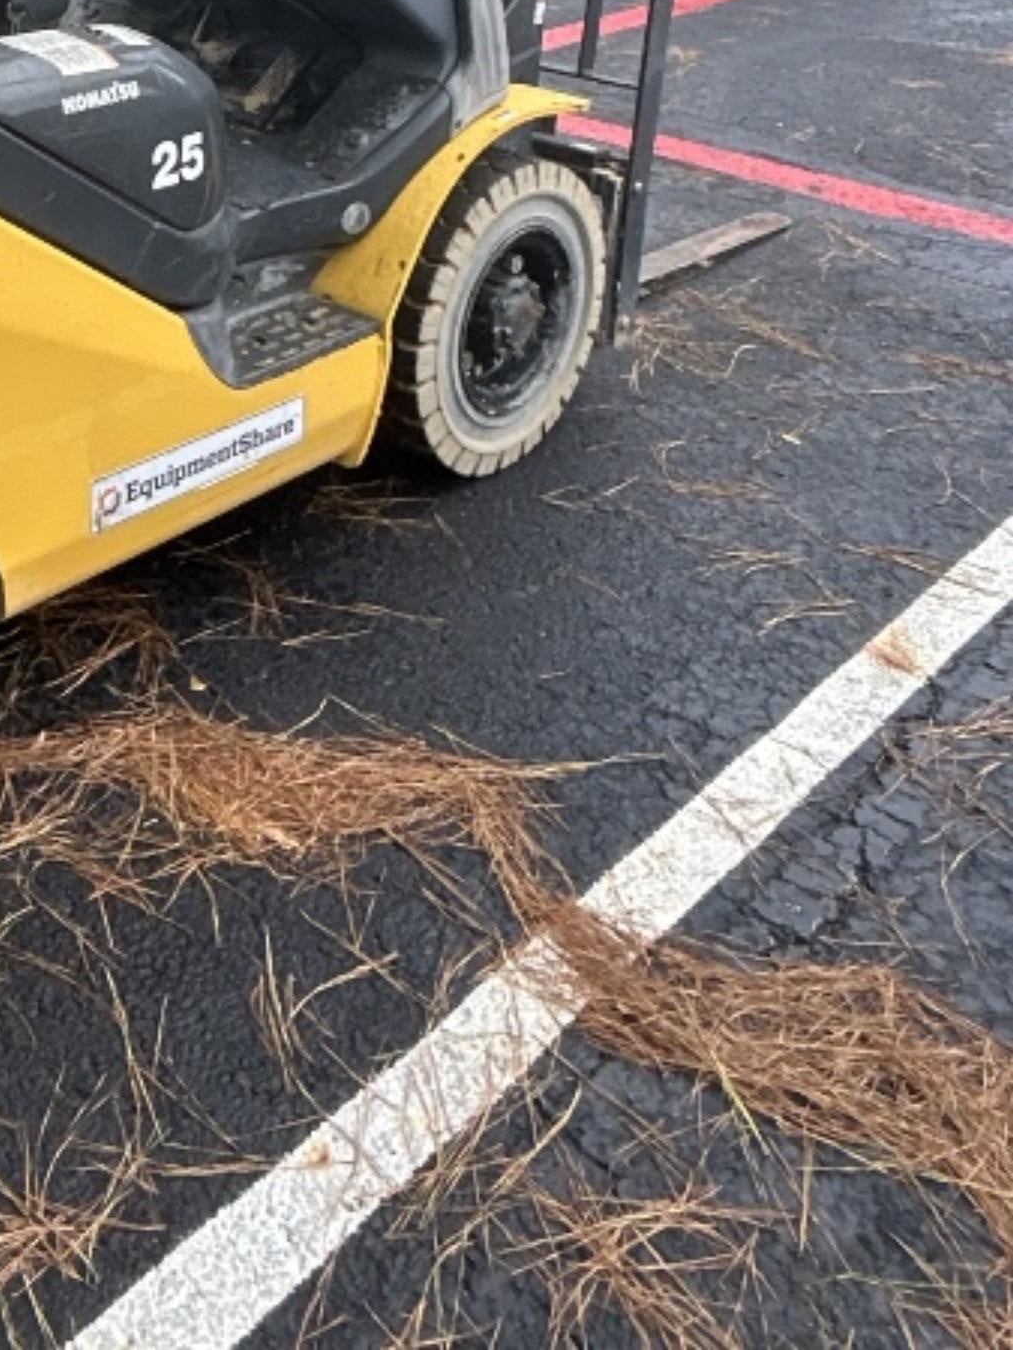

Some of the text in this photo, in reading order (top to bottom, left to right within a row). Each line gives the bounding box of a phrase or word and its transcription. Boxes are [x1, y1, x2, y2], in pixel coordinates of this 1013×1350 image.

[60, 80, 141, 115] KOMATSU
[151, 131, 204, 190] 25
[126, 418, 295, 502] EquipmentShare
